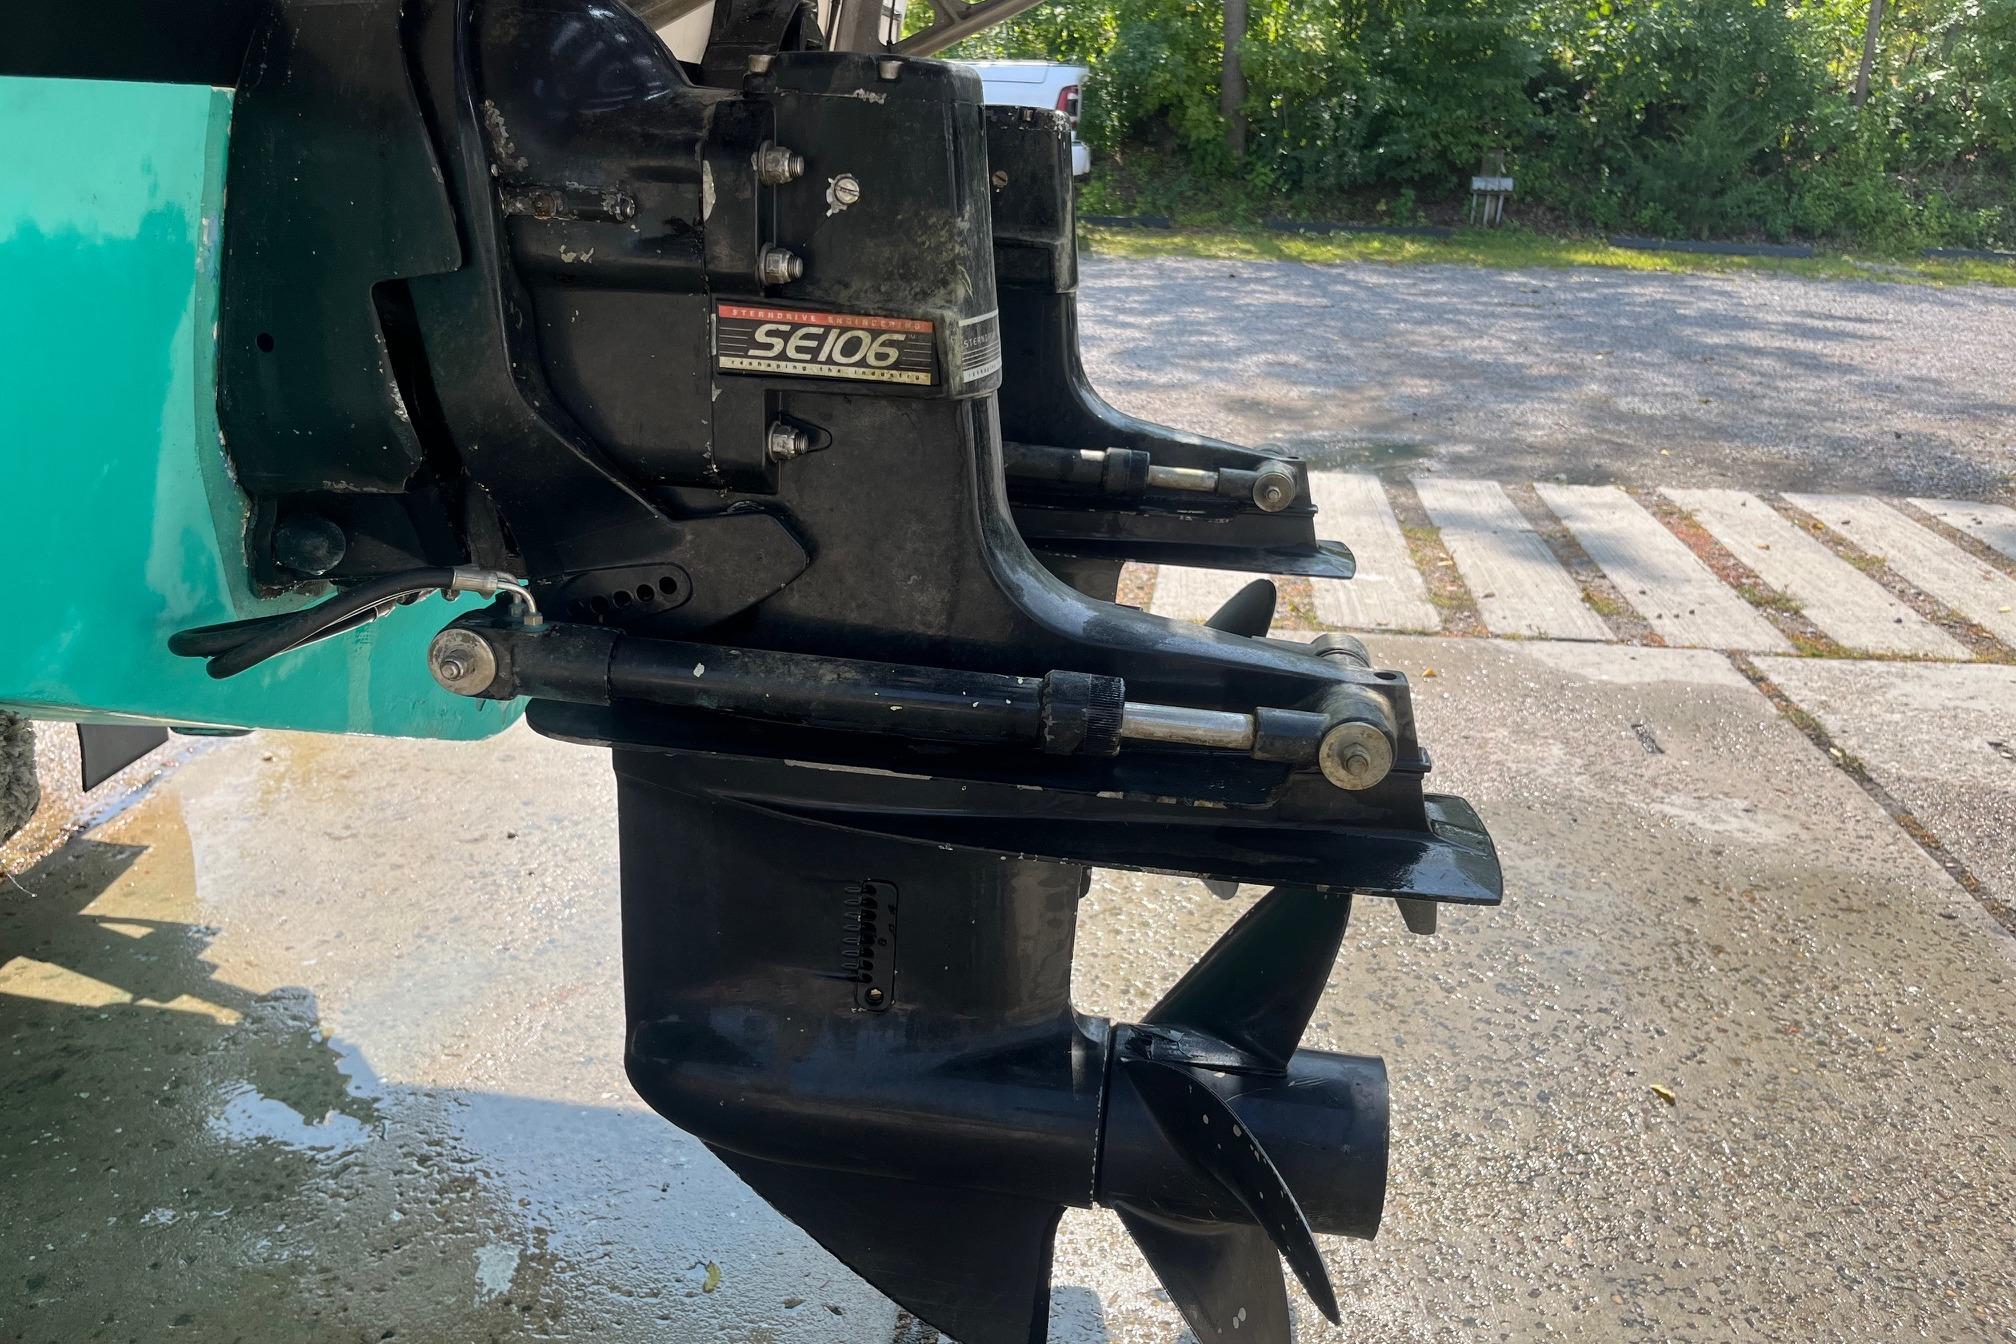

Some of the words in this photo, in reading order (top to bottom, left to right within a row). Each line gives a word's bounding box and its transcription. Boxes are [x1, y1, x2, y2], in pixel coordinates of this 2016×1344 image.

[731, 308, 817, 323] STERNDRIVE
[747, 323, 906, 367] SE106
[731, 359, 807, 372] reshaping
[819, 365, 842, 374] the
[854, 369, 920, 381] industry
